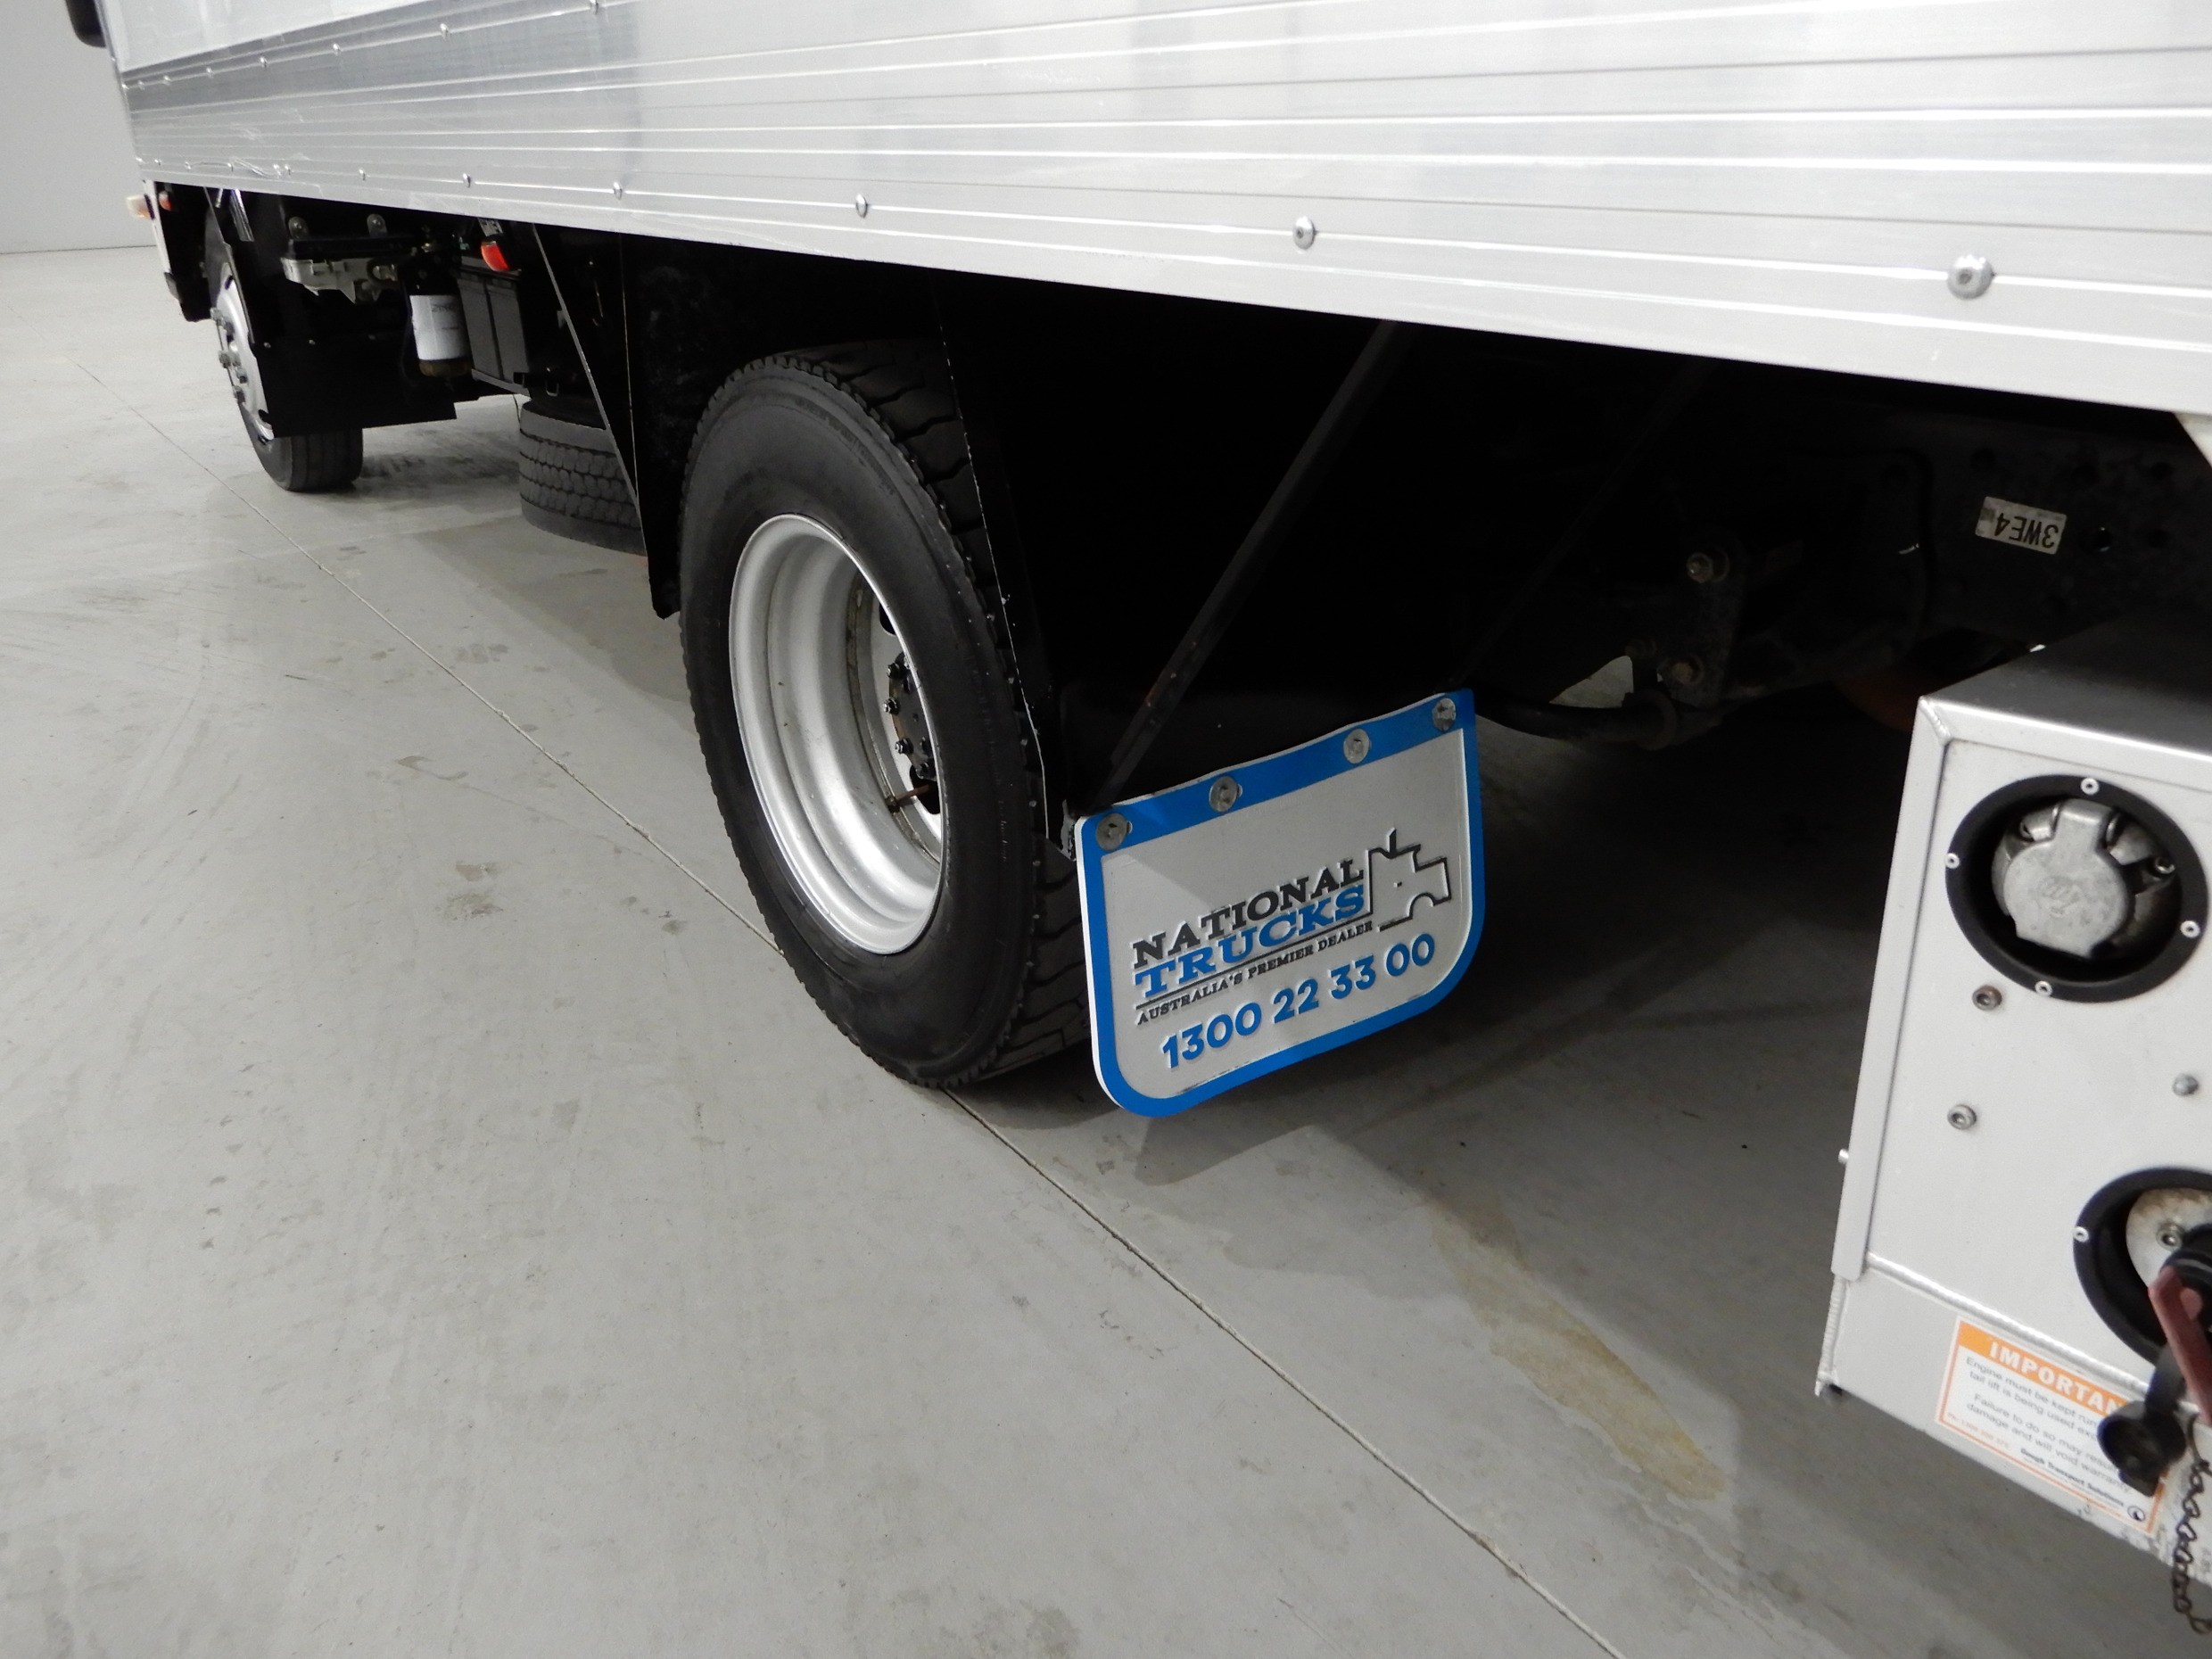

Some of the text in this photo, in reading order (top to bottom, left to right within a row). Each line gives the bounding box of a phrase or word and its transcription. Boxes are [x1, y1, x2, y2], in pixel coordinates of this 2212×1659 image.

[1993, 512, 2059, 549] 3WE4
[1132, 859, 1364, 970] NATIONAL
[1134, 884, 1365, 998] TRUCKS
[1136, 920, 1373, 1026] AUSTRALIA'S PREMIER DEALER
[1162, 933, 1435, 1069] 1300 22 33 00
[1966, 1356, 2075, 1417] Engine must be kept
[1969, 1370, 1985, 1384] tail
[1987, 1381, 2000, 1391] lift
[2002, 1388, 2011, 1397] is
[2014, 1393, 2043, 1416] being
[2047, 1411, 2075, 1428] used
[1989, 1341, 2125, 1416] IMPORTAN
[1967, 1402, 2009, 1429] damage
[2011, 1426, 2032, 1441] and
[2035, 1438, 2051, 1451] will
[2056, 1449, 2077, 1465] void
[1974, 1393, 2010, 1417] Failure
[2012, 1414, 2023, 1425] to
[2026, 1421, 2040, 1433] do
[2043, 1430, 2056, 1441] so
[2059, 1439, 2081, 1455] may
